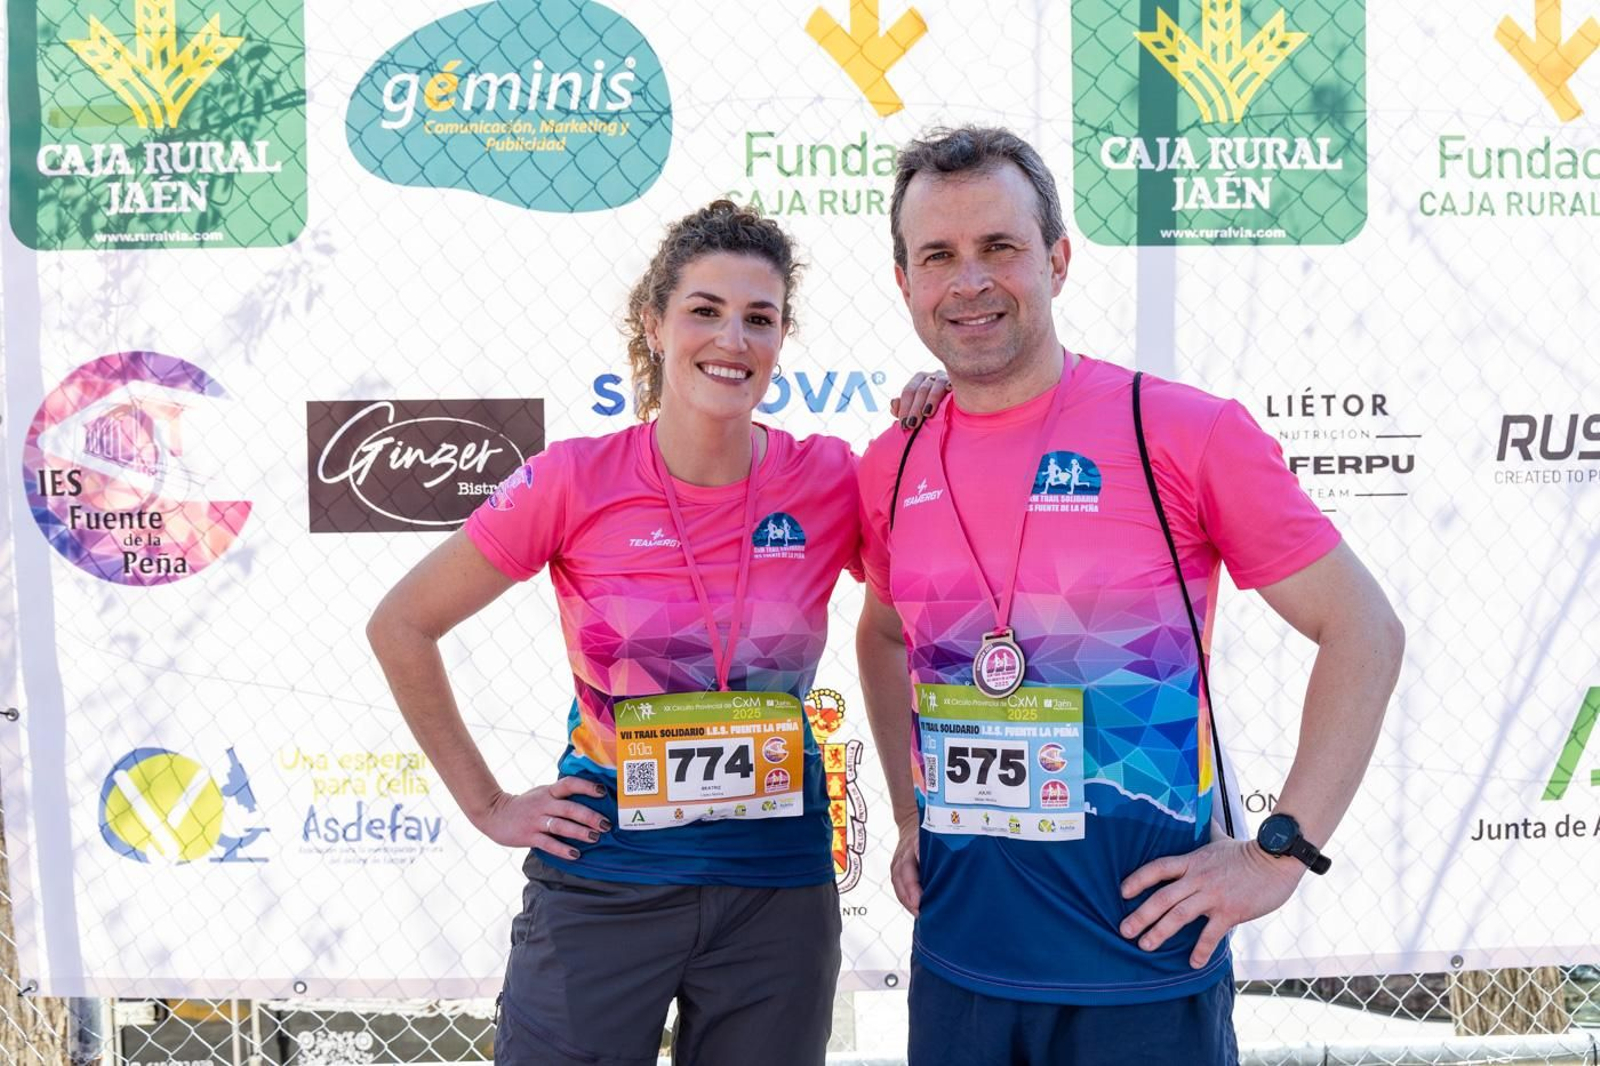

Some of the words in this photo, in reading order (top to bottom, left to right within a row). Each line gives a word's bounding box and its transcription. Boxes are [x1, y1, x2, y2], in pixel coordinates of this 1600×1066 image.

[381, 59, 635, 130] géminis
[540, 119, 617, 136] Marketing
[620, 121, 630, 135] y
[485, 136, 566, 152] Publicidad
[1100, 136, 1200, 171] CAJA
[1207, 136, 1343, 170] RURAL
[36, 143, 136, 177] CAJA
[142, 140, 282, 175] RURAL
[105, 175, 209, 216] JAÉN
[1172, 170, 1272, 211] JAÉN
[1419, 191, 1496, 216] CAJA
[1506, 191, 1600, 216] RURAL
[93, 230, 224, 244] www.ruralvia.com
[1160, 227, 1287, 240] www.ruralvia.com
[1266, 386, 1389, 418] LIÉTOR
[38, 470, 82, 497] IES
[1494, 470, 1561, 485] CREATED
[1565, 469, 1584, 483] TO
[70, 505, 162, 530] Fuente
[123, 533, 142, 547] de
[148, 532, 161, 547] la
[123, 551, 187, 574] Peña
[732, 696, 761, 708] CxM
[1007, 694, 1038, 708] CxM
[732, 708, 761, 720] 2025
[1008, 708, 1038, 721] 2025
[620, 731, 632, 740] VII
[634, 730, 658, 739] TRAIL
[660, 727, 705, 738] SOLIDARIO
[763, 723, 774, 732] LA
[775, 719, 799, 731] PEÑA
[940, 724, 980, 735] SOLIDARIO
[1039, 727, 1052, 737] LA
[1053, 723, 1079, 737] PEÑA
[280, 749, 328, 770] Una
[668, 744, 754, 783] 774
[945, 746, 1027, 787] 575
[313, 776, 366, 800] para
[302, 800, 441, 843] Asdefav
[1471, 818, 1546, 841] Junta
[1555, 814, 1586, 838] de
[842, 906, 868, 916] NTO
